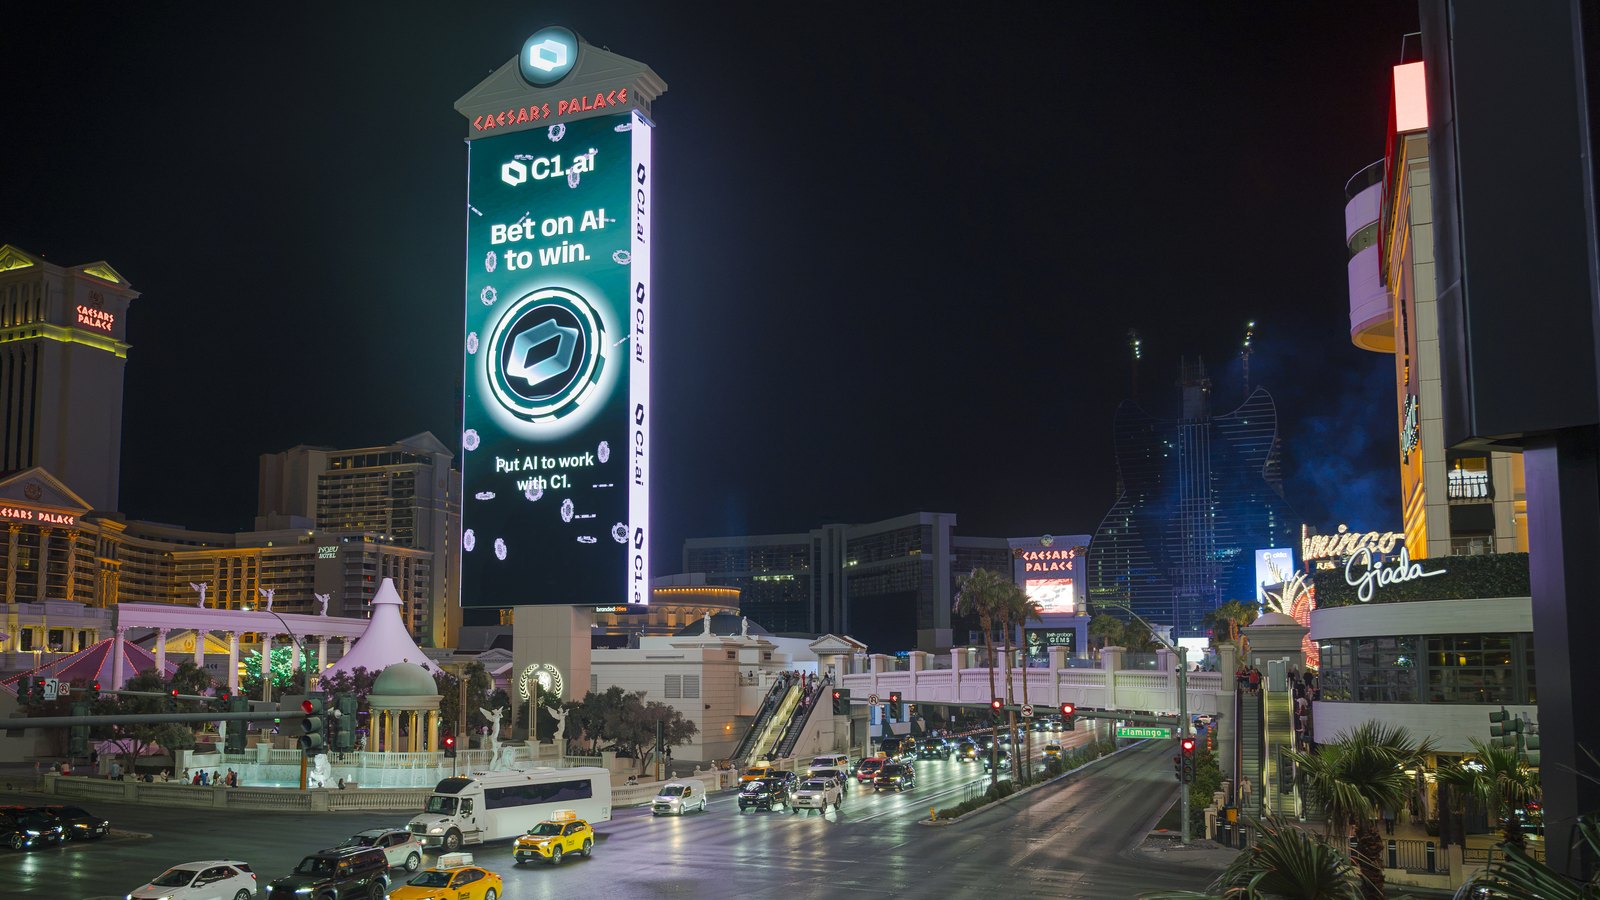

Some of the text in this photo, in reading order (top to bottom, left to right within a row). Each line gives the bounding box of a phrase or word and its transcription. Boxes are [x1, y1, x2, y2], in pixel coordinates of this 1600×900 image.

[473, 88, 628, 131] CAESARS PALACE
[531, 147, 595, 180] C1.ai
[491, 208, 605, 245] Bet on AI
[636, 188, 646, 244] C1.ai
[504, 240, 591, 271] to win.
[76, 304, 114, 331] CAESARS PALACE
[636, 308, 645, 364] C1.ai
[496, 451, 594, 473] Put AI to work
[635, 430, 644, 486] C1.ai
[517, 474, 571, 491] with C1.
[0, 507, 74, 525] ESARS PALACE
[1022, 550, 1076, 561] CAESARS
[1025, 561, 1073, 572] PALACE
[1345, 546, 1447, 602] Giada
[1121, 728, 1162, 738] Flamingo
